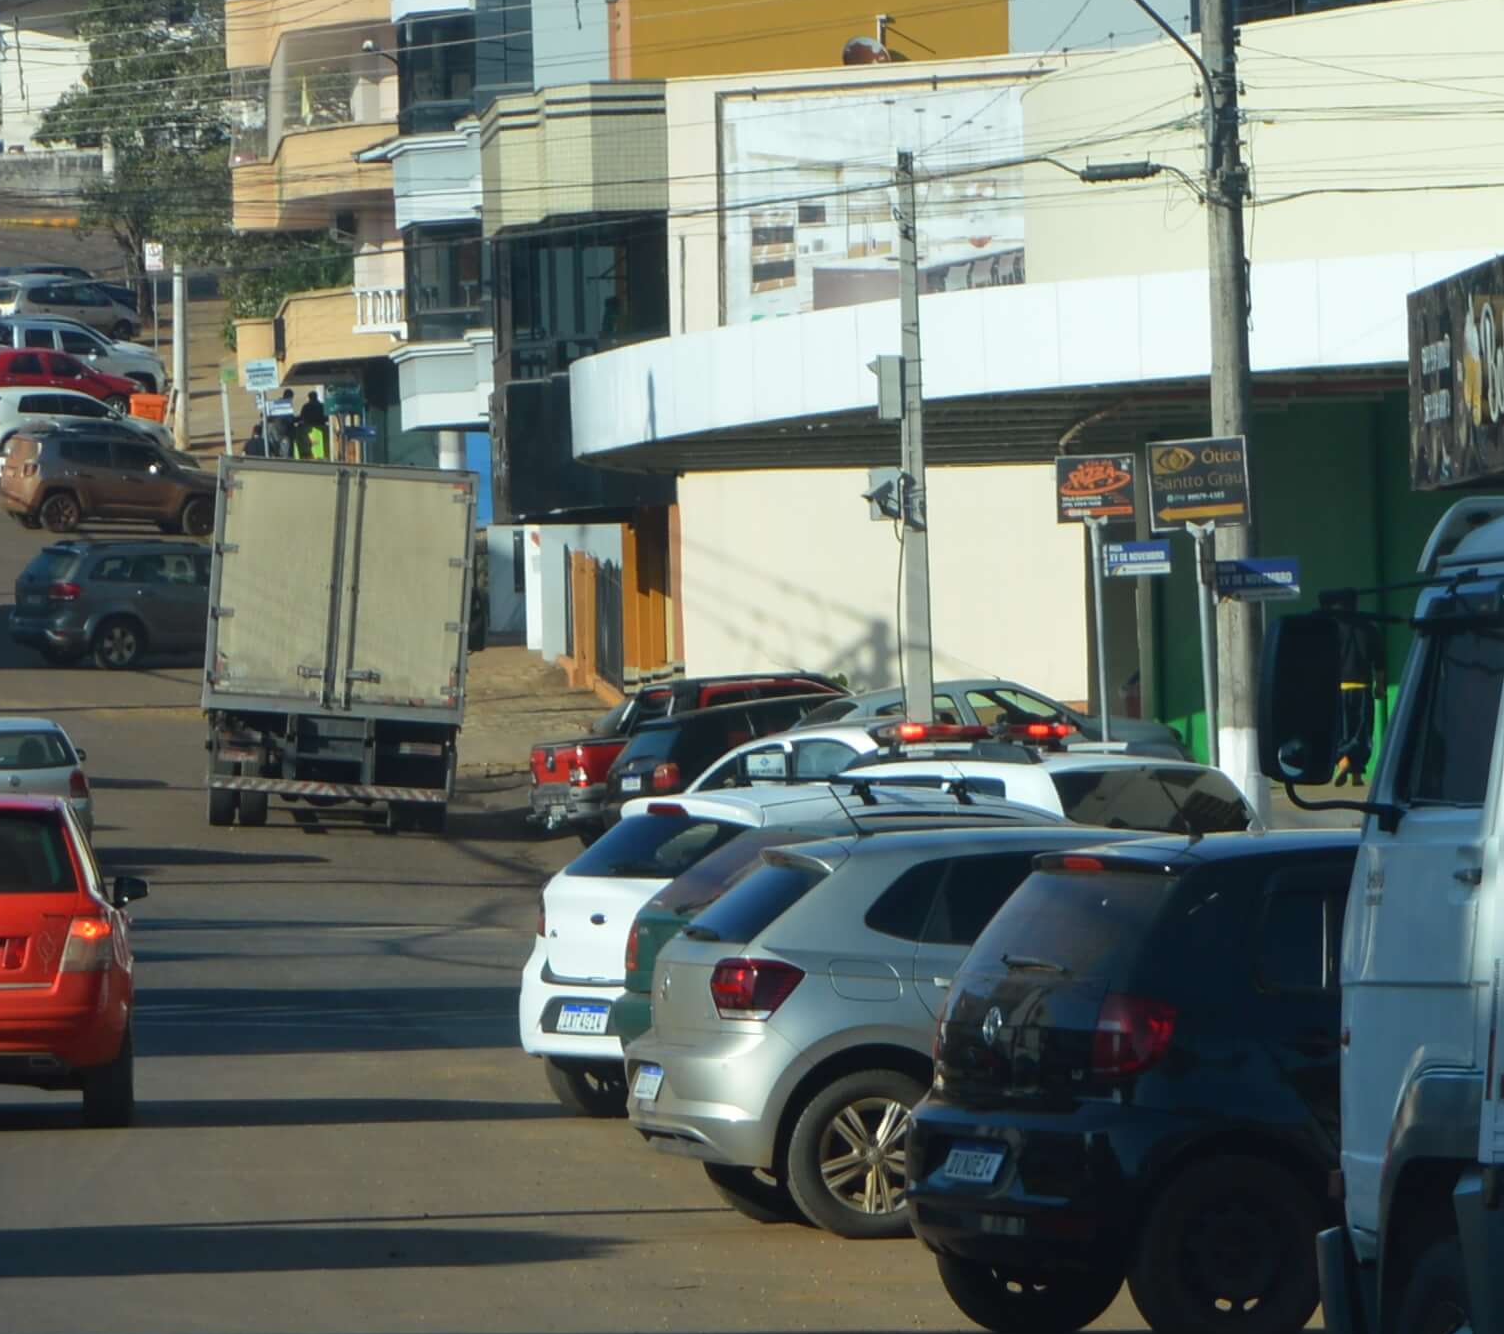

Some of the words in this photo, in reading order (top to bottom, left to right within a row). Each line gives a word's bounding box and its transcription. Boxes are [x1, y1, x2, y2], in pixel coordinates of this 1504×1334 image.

[1200, 447, 1242, 465] Ótica
[1153, 474, 1203, 492] Santto
[1207, 471, 1243, 487] Grau
